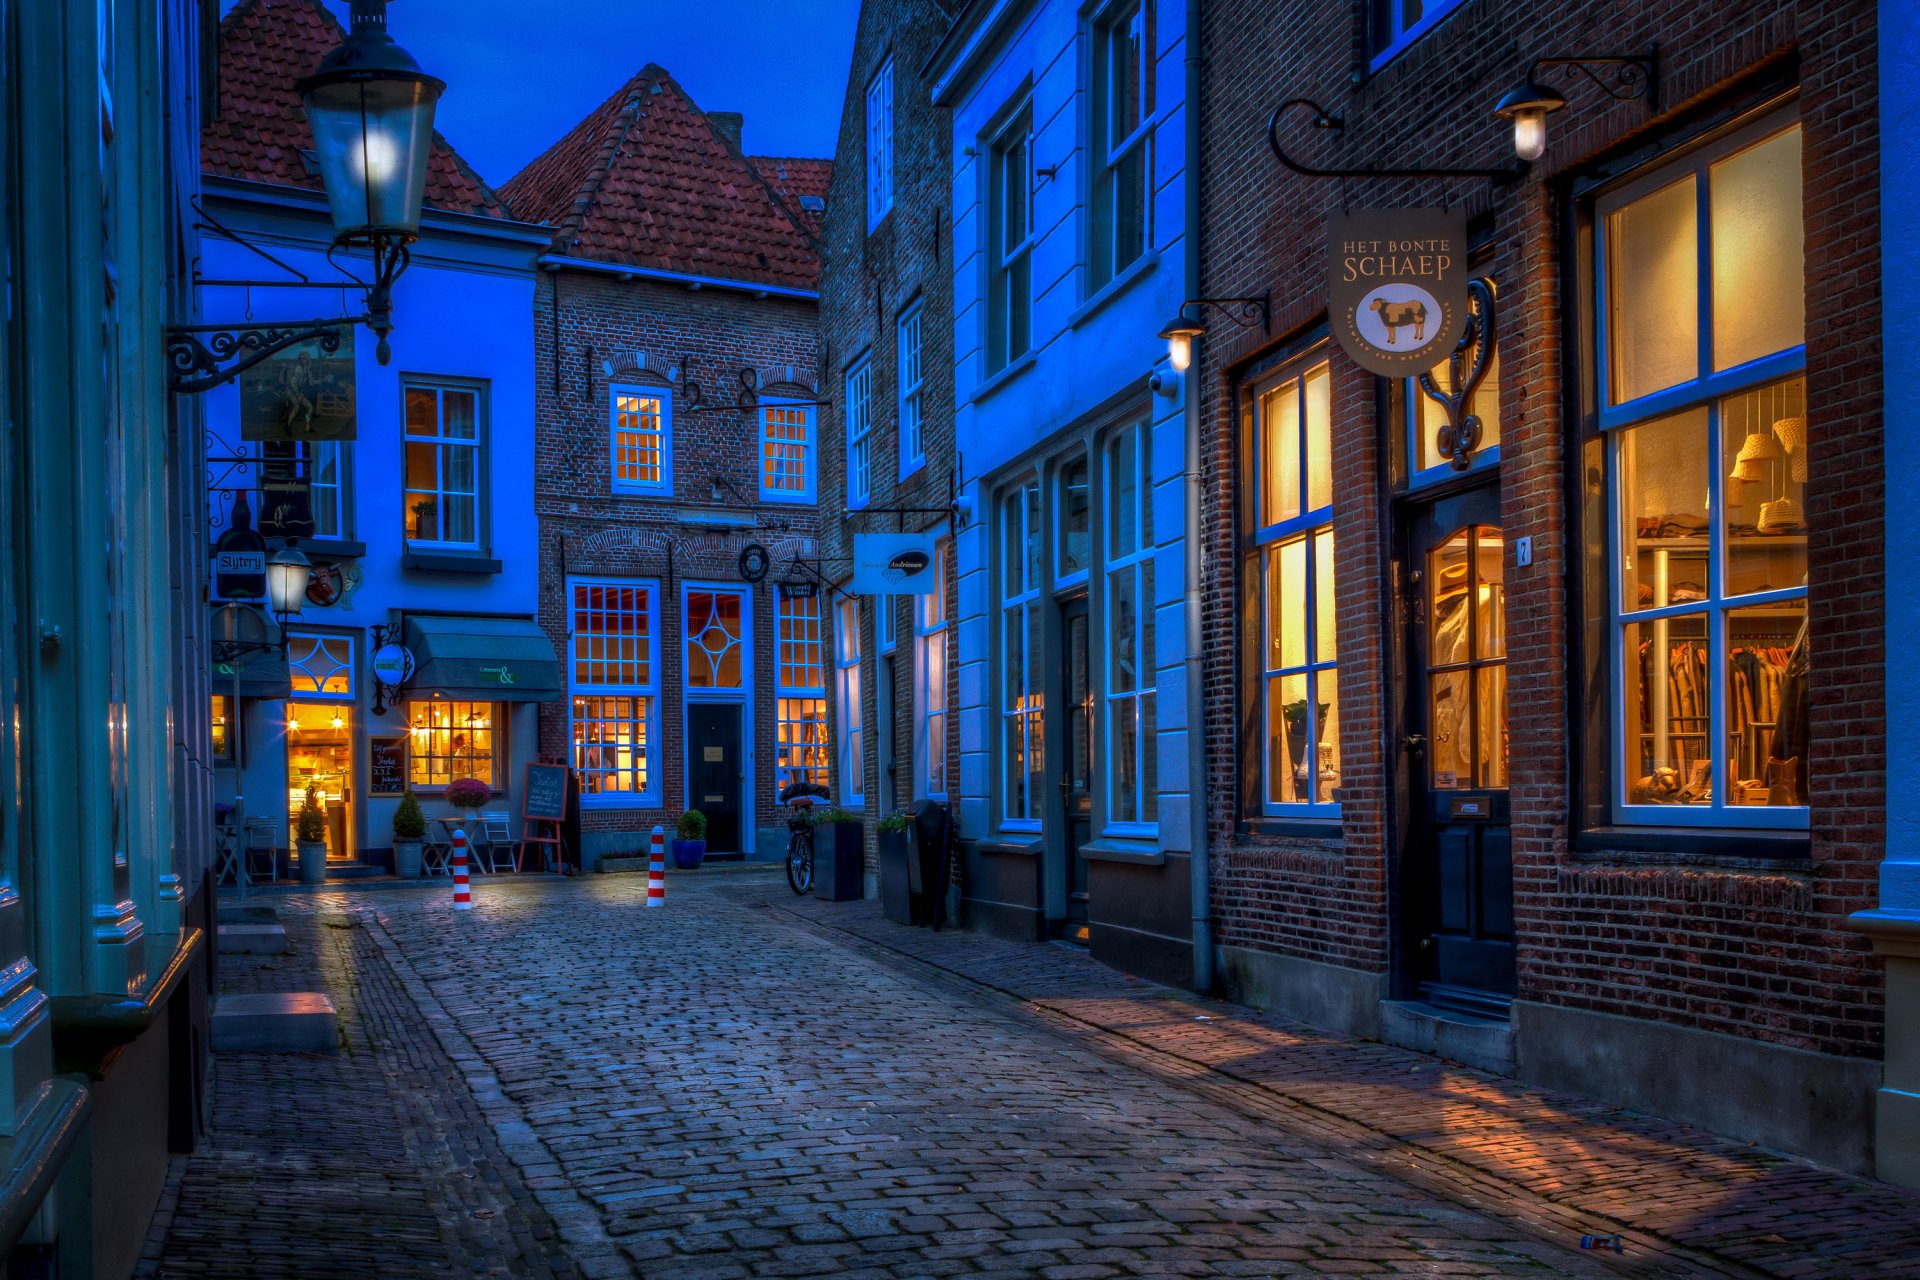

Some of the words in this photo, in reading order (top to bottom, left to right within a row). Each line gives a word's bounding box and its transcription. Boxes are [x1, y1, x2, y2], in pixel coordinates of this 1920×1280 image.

[1343, 241, 1382, 254] HET
[1388, 239, 1450, 253] BONTE
[1343, 254, 1452, 282] SCHAEP
[1519, 542, 1527, 563] 7
